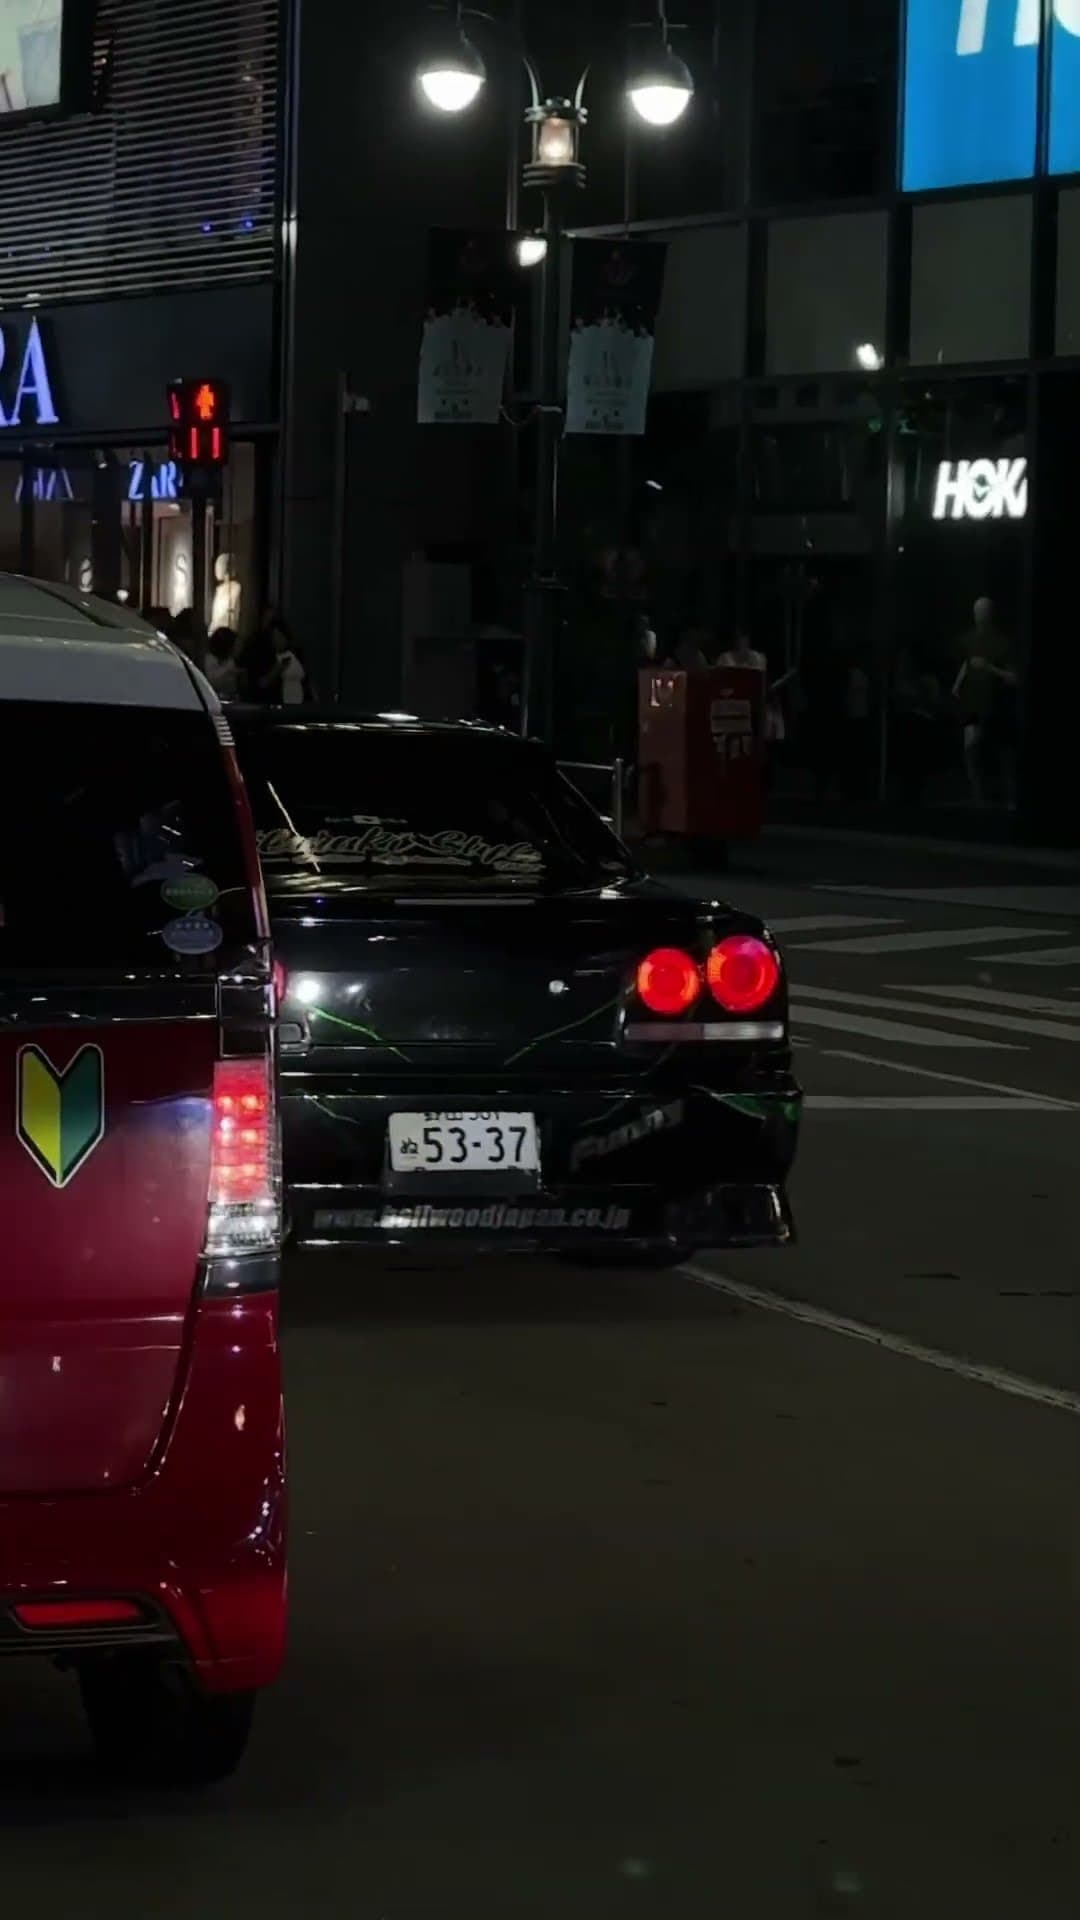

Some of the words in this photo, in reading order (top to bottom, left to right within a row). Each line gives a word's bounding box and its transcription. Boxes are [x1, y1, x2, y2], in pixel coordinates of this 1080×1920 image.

[0, 315, 59, 427] A
[932, 456, 1028, 519] HOK
[423, 1126, 527, 1164] 53-37
